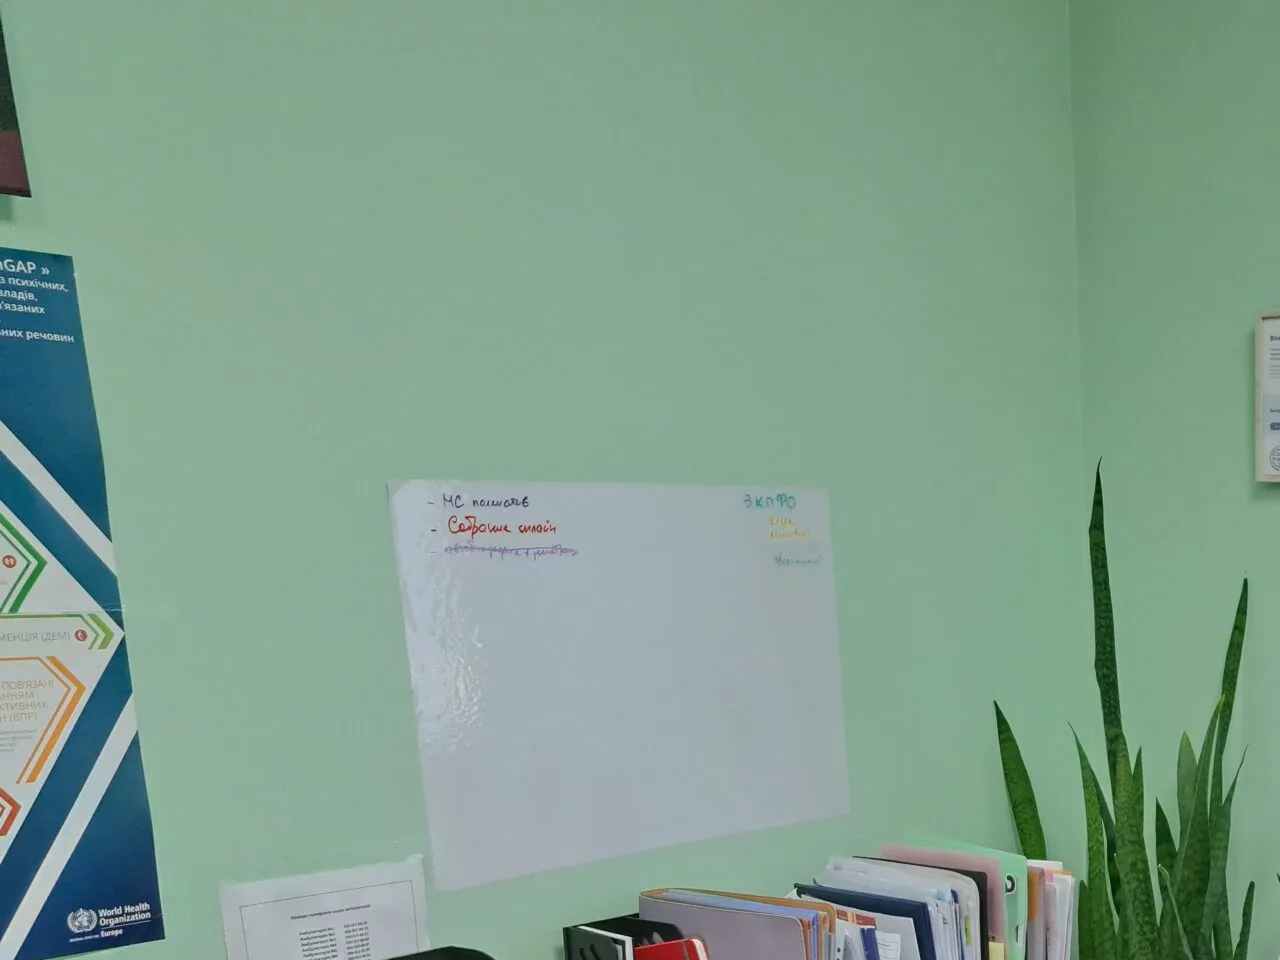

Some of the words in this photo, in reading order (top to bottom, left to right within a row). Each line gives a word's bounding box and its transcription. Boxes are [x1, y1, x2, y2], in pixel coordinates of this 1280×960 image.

[8, 277, 69, 292] психічних,
[26, 331, 74, 342] речовин
[98, 906, 122, 917] World
[124, 902, 150, 914] Health
[99, 912, 151, 927] Organization
[100, 929, 123, 937] Europe
